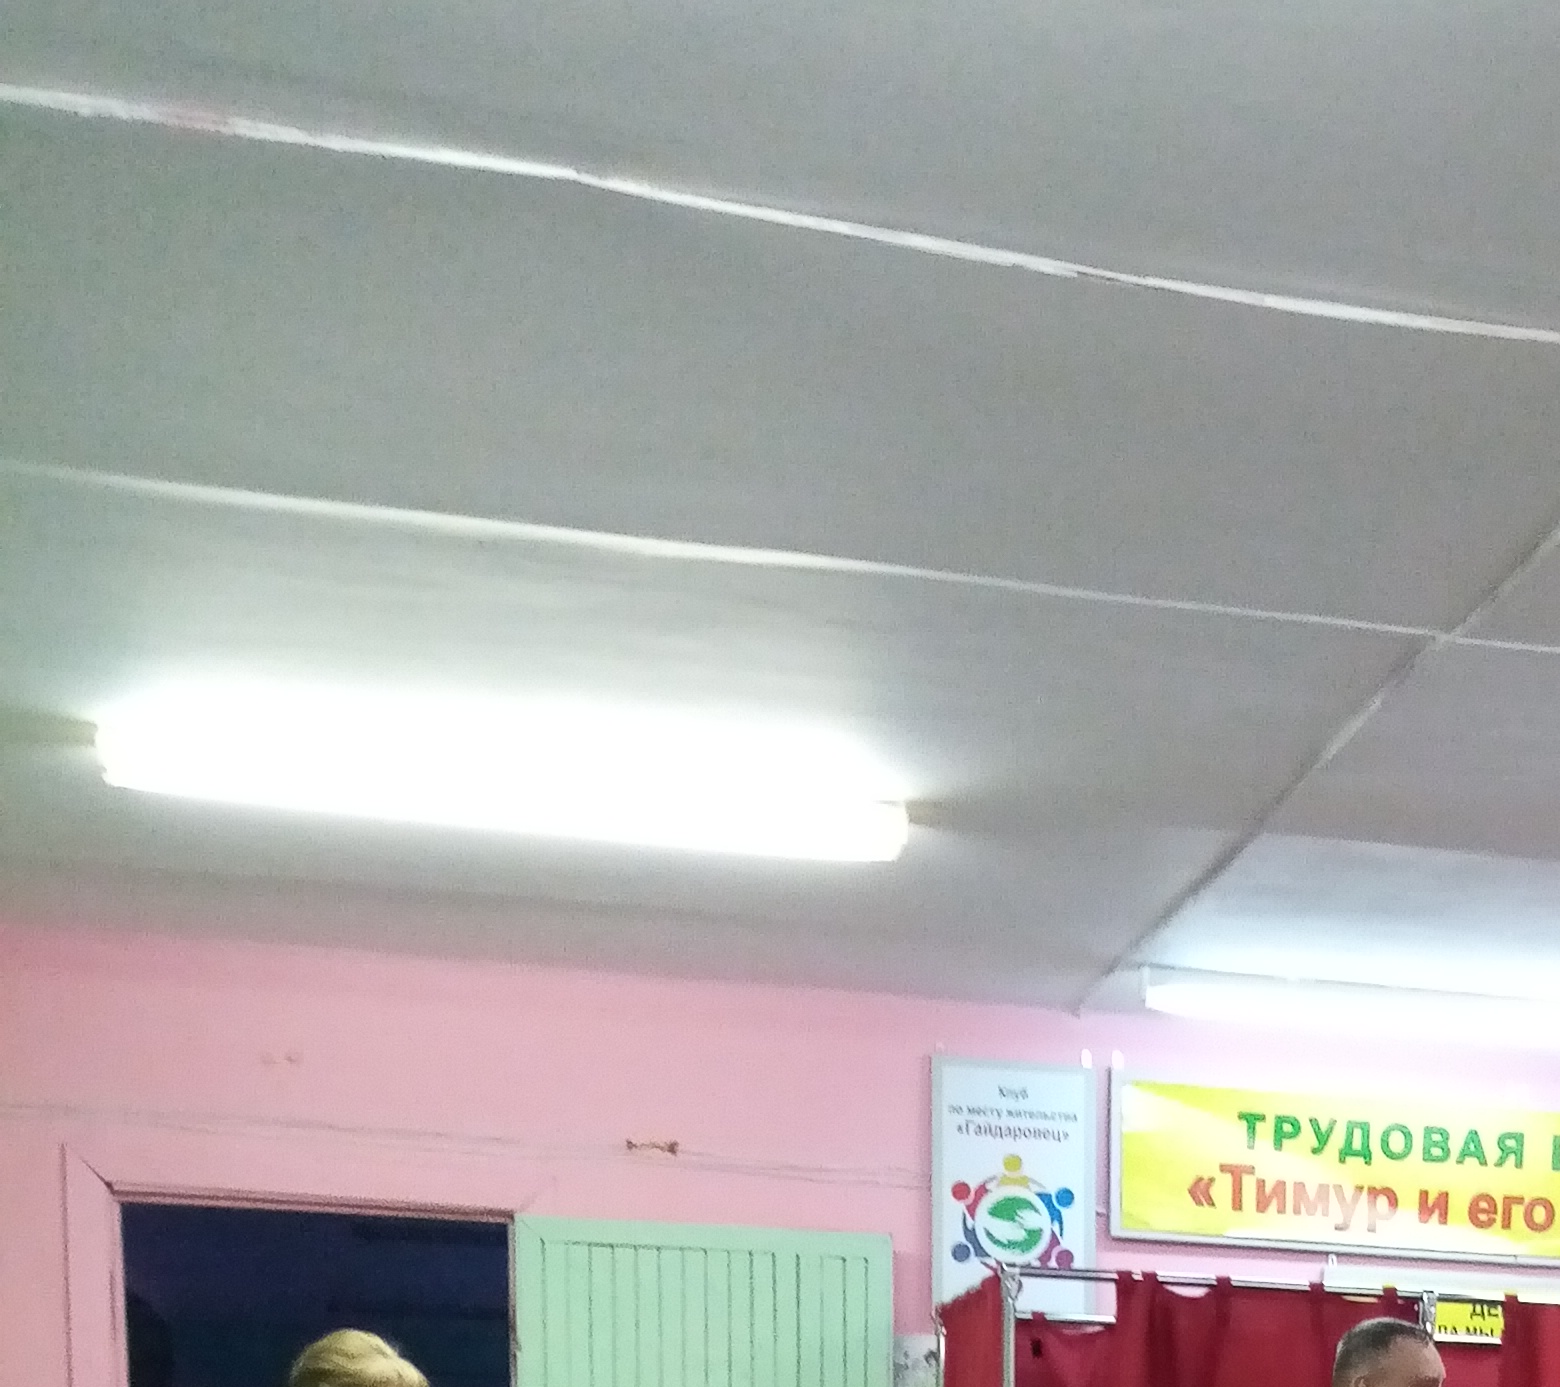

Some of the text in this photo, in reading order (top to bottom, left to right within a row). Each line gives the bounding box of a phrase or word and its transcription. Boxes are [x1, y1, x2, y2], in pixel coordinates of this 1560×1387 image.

[1237, 1111, 1525, 1170] ТРУДОВАЯ
[1187, 1162, 1399, 1233] «Тимур
[1418, 1188, 1450, 1226] и
[1468, 1191, 1556, 1233] его
